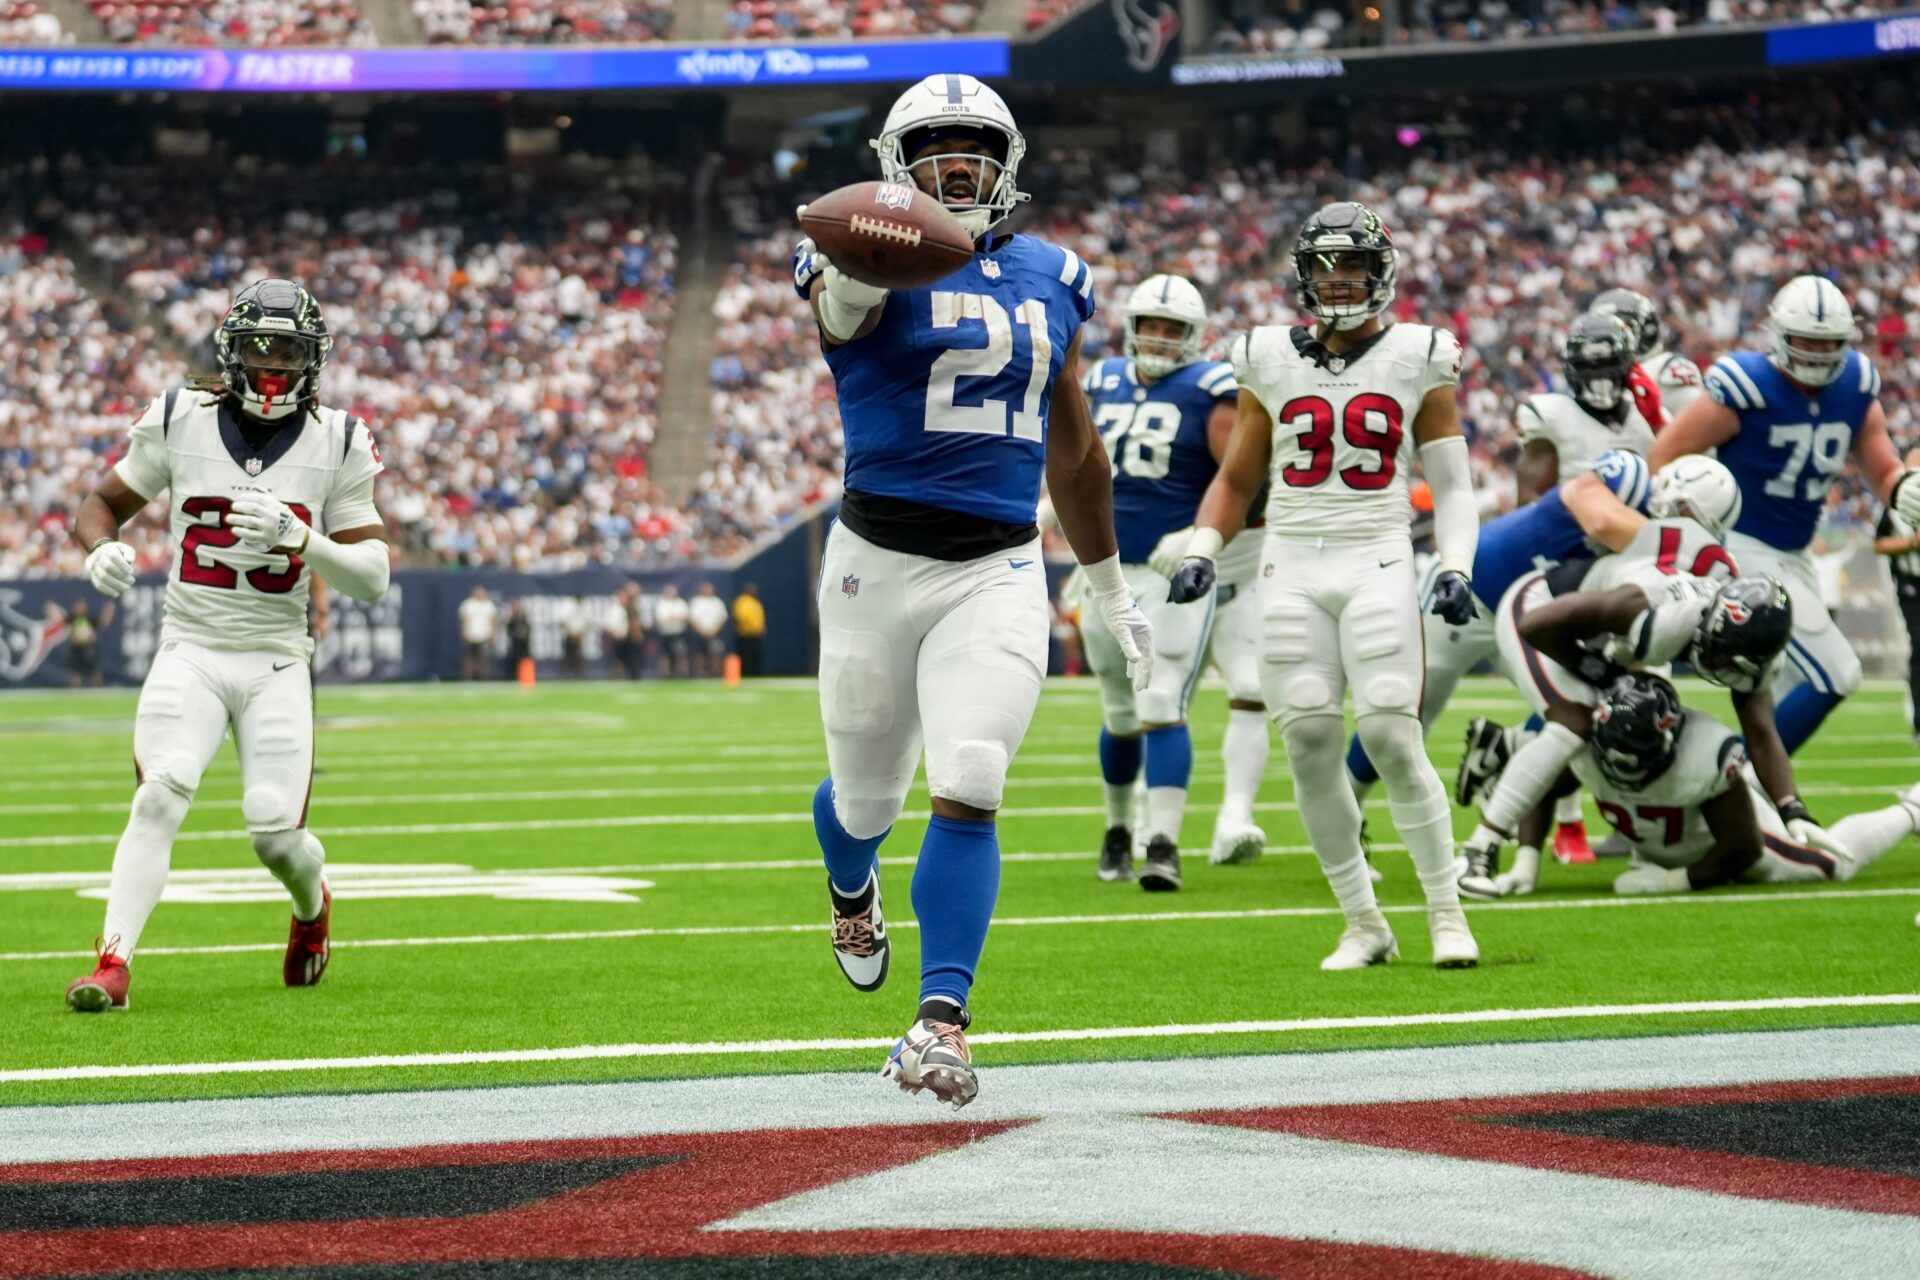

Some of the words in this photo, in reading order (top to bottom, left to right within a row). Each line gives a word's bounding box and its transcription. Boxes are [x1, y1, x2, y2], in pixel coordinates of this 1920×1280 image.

[52, 57, 128, 79] NEVER
[237, 54, 354, 85] FASTER
[677, 49, 763, 83] xfinity
[924, 291, 1052, 443] 21
[1095, 401, 1182, 479] 78
[1279, 392, 1404, 490] 39
[1764, 422, 1853, 501] 79
[230, 485, 273, 493] TEXAS
